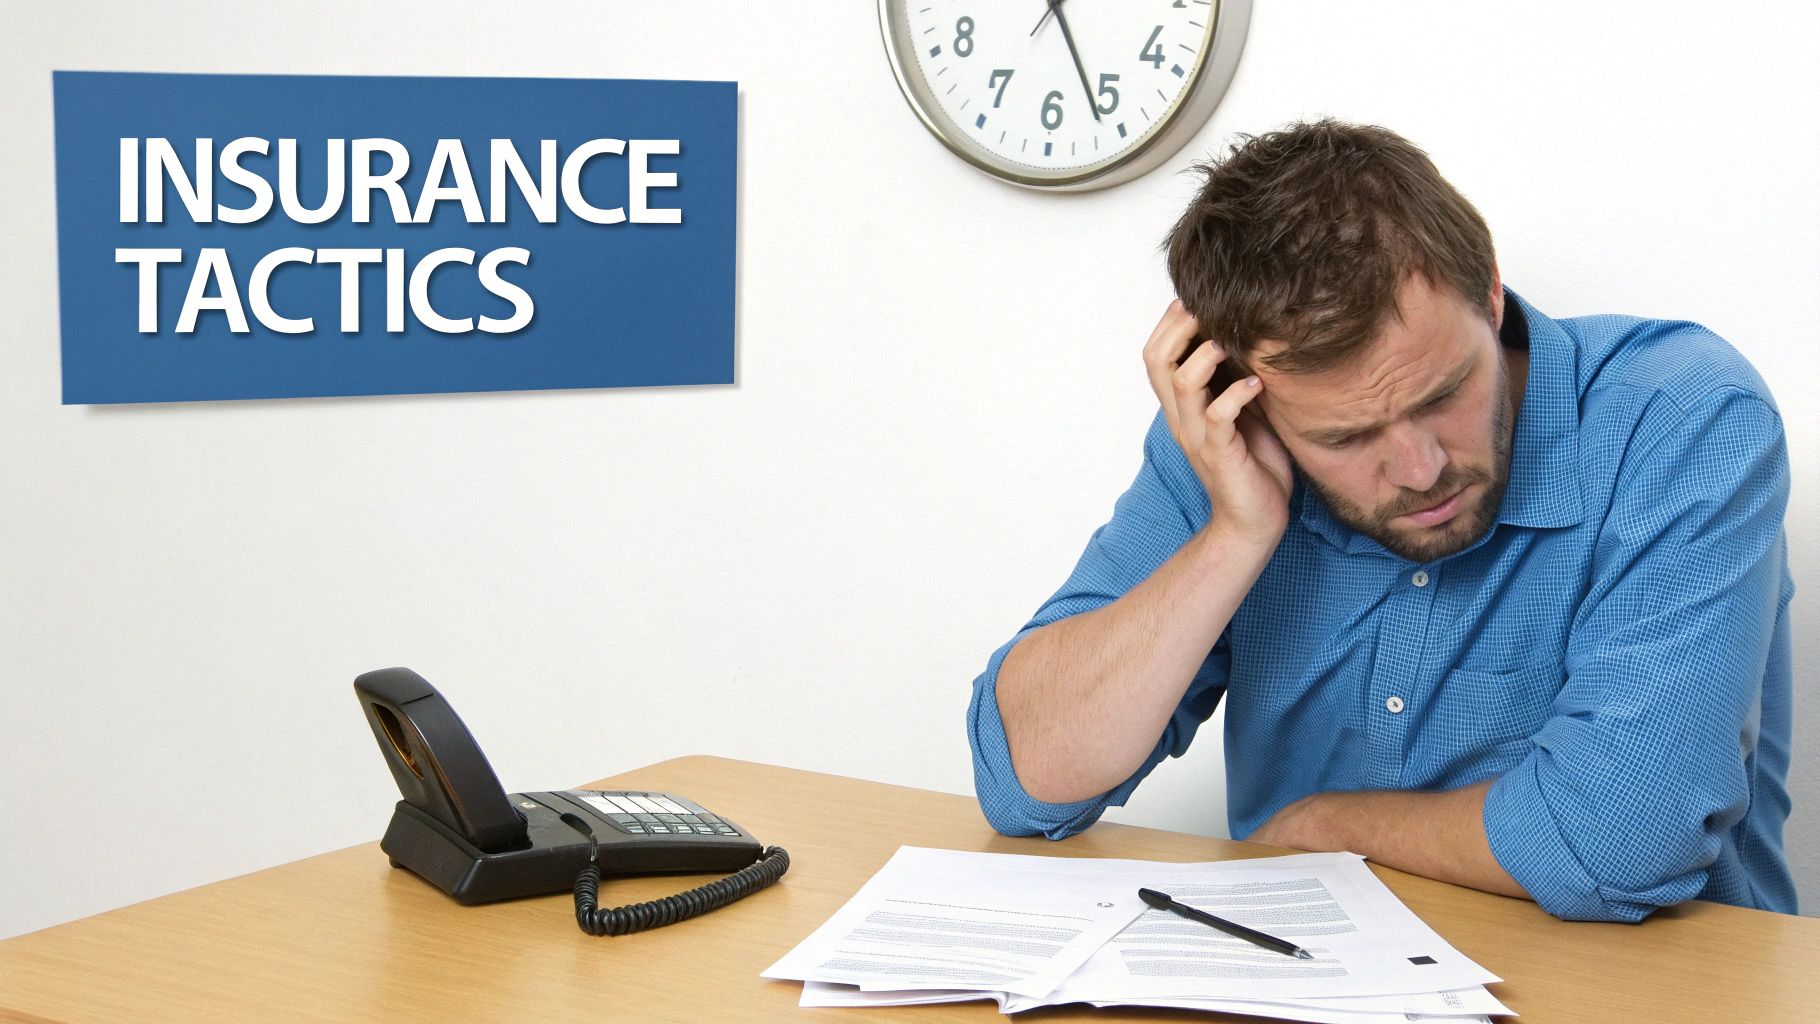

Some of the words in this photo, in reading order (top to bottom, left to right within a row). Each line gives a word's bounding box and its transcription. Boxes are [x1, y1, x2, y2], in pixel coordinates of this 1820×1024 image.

[953, 15, 975, 58] 8
[1139, 25, 1166, 70] 4
[988, 69, 1015, 109] 7
[1040, 90, 1064, 131] 6
[1097, 73, 1120, 115] 5
[119, 136, 682, 224] INSURANCE
[115, 246, 534, 334] TACTICS
